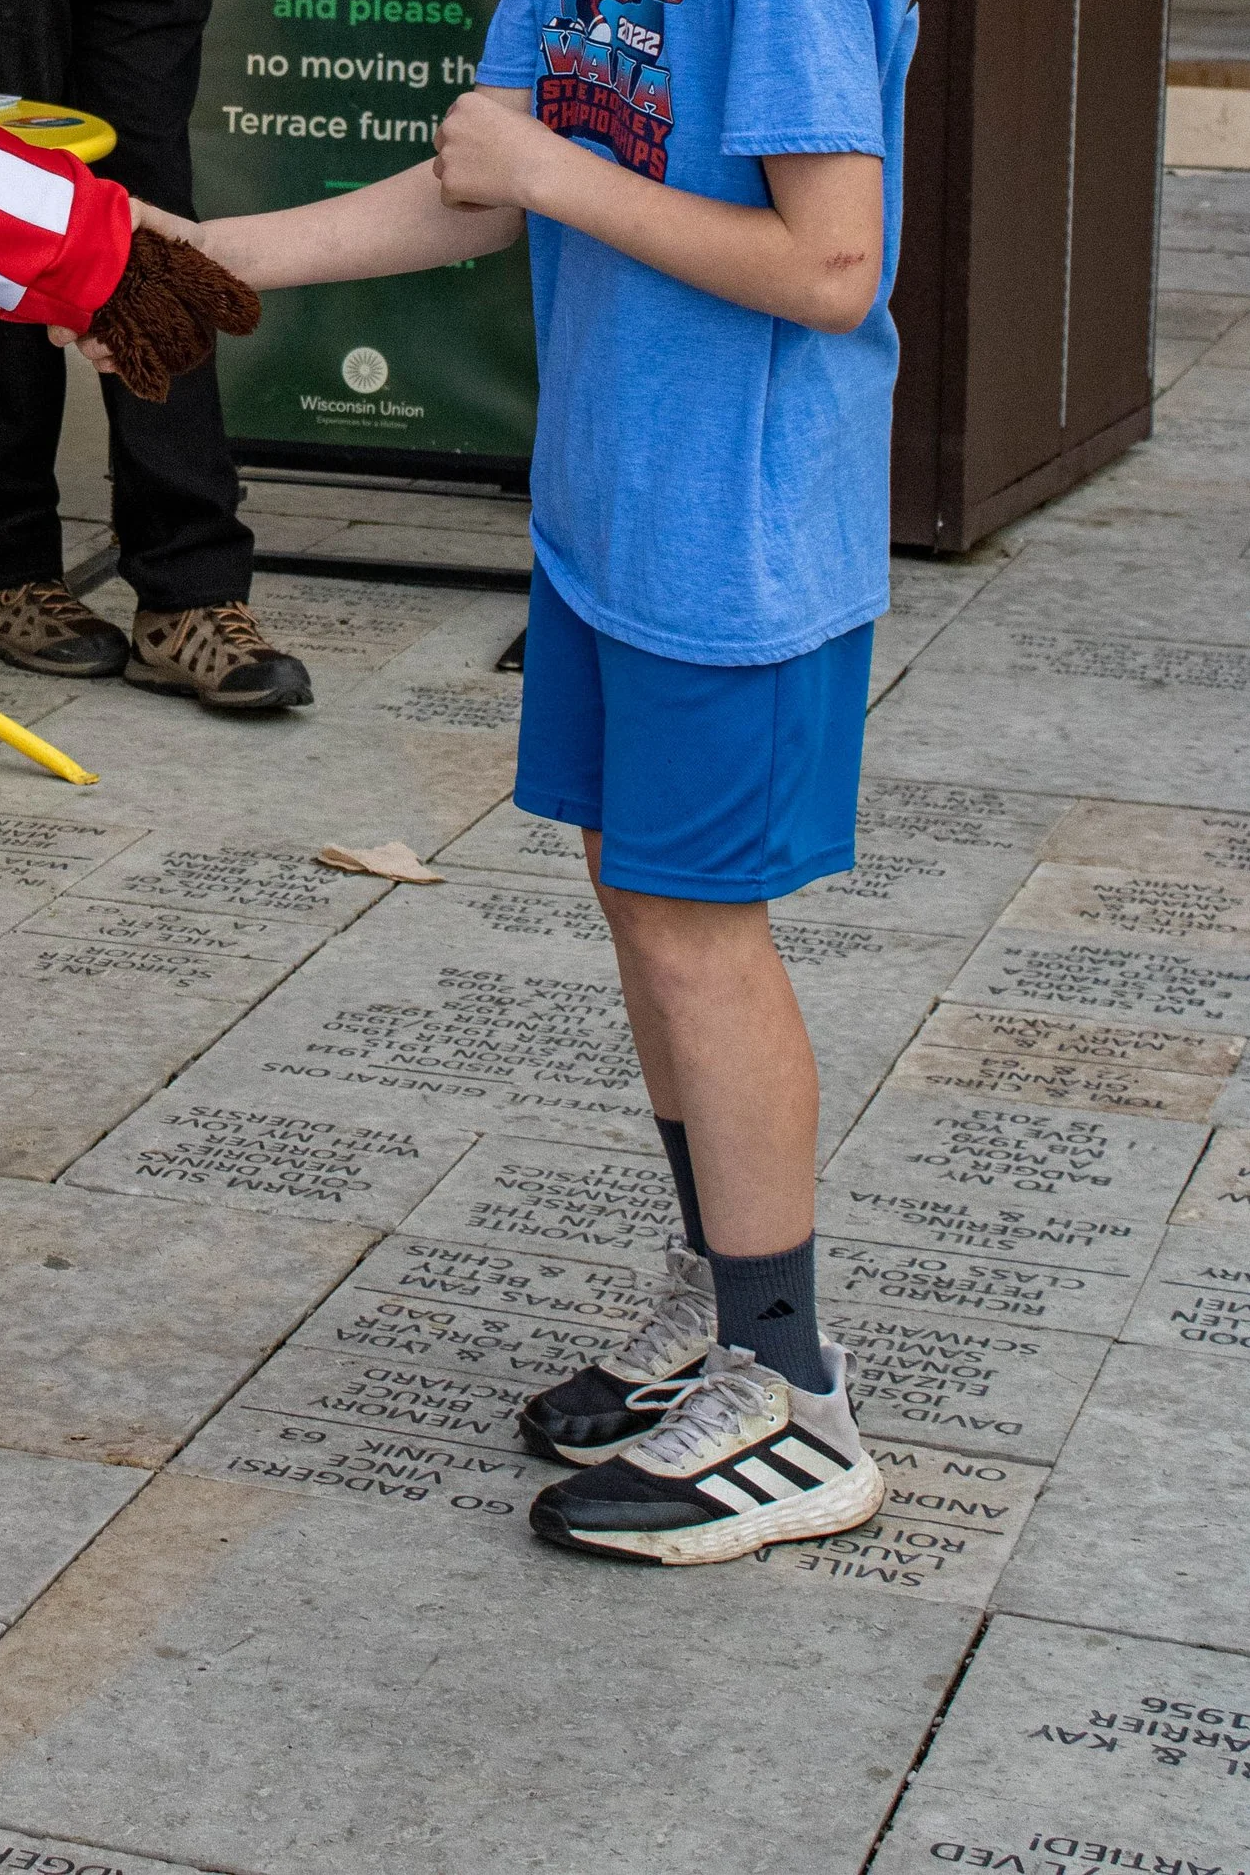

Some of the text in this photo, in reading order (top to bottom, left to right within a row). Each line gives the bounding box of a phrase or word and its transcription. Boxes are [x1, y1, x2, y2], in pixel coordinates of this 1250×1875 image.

[616, 15, 662, 57] 2022
[247, 53, 476, 89] no moving th
[222, 105, 440, 143] Terrace furni
[300, 395, 425, 418] Wisconsin Union
[453, 1013, 594, 1038] STENDER
[529, 1010, 585, 1025] LUX
[321, 1022, 553, 1057] STENDER 1950
[364, 1038, 575, 1072] RISDON 1915
[1057, 1043, 1128, 1059] TOM
[1078, 1034, 1165, 1052] MARY
[305, 1043, 514, 1076] RISDON 1914
[925, 1075, 1167, 1111] TOM CHRIS
[978, 1068, 1129, 1093] GRANNIS
[188, 1105, 415, 1144] THE DUERSTS
[933, 1117, 1108, 1147] LOVE YOU
[970, 1109, 1050, 1127] 2013
[157, 1113, 419, 1159] WITH MY LOVE
[203, 1133, 356, 1162] FOREVER
[136, 1151, 372, 1191] COLD DRINKS
[173, 1142, 362, 1176] MEMORIES
[902, 1152, 1112, 1187] BADGER OF
[135, 1164, 343, 1203] WARM SUN
[937, 1169, 1058, 1195] TO MY
[470, 1202, 596, 1229] IN THE
[848, 1191, 1131, 1238] RICH TRISHA
[465, 1216, 633, 1249] FAVORITE
[927, 1230, 1016, 1252] STILL
[404, 1245, 513, 1271] CHRIS
[827, 1247, 1084, 1290] CLASS OF '73
[398, 1274, 481, 1297] FAM
[409, 1261, 531, 1289] BETTY
[851, 1265, 1044, 1300] PETERSON
[375, 1303, 455, 1326] DAD
[879, 1285, 1046, 1317] RICHARD
[335, 1328, 430, 1355] LYDIA
[353, 1316, 522, 1352] FOREVER
[826, 1318, 1040, 1355] SCHWARTZ
[826, 1331, 985, 1362] SAMUEL
[340, 1381, 473, 1414] BRUCE
[306, 1395, 492, 1435] MEMORY
[892, 1403, 1023, 1435] DAVID,
[322, 1453, 442, 1484] VINCE
[354, 1439, 526, 1479] LATUNIK
[943, 1462, 1007, 1482] ON
[226, 1455, 514, 1515] GO BADGERS!
[795, 1553, 924, 1587] SMILE
[1027, 1725, 1118, 1753] KAY
